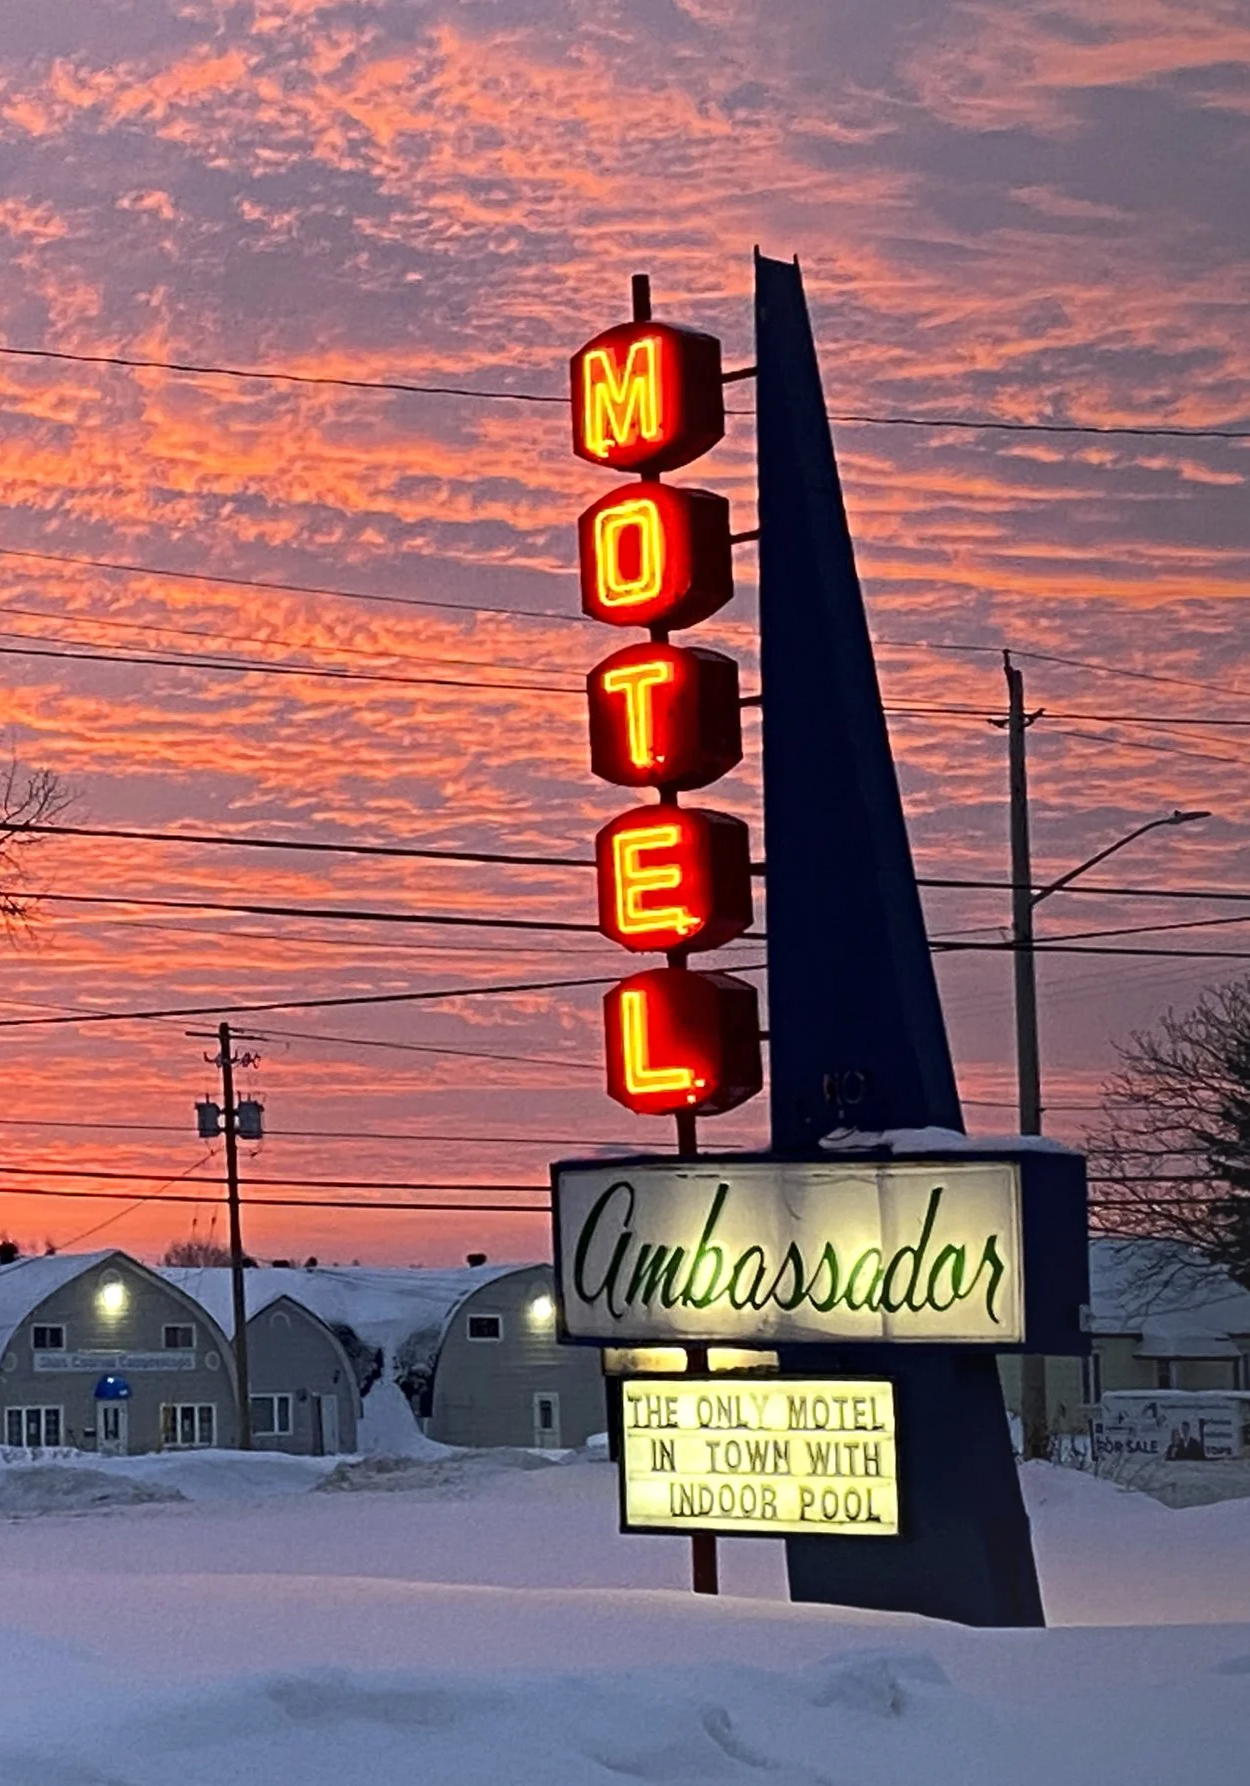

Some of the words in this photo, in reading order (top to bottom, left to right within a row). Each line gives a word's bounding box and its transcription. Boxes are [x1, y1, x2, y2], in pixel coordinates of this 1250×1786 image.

[583, 336, 702, 1097] MOTEL
[573, 1180, 1005, 1324] Ambassador
[627, 1394, 679, 1429] THE
[696, 1394, 770, 1429] ONLY
[786, 1395, 885, 1432] MOTEL
[650, 1438, 676, 1473] IN
[706, 1439, 791, 1474] TOWN
[806, 1440, 882, 1477] WITH
[669, 1482, 777, 1520] INDOOR
[799, 1486, 882, 1523] POOL
